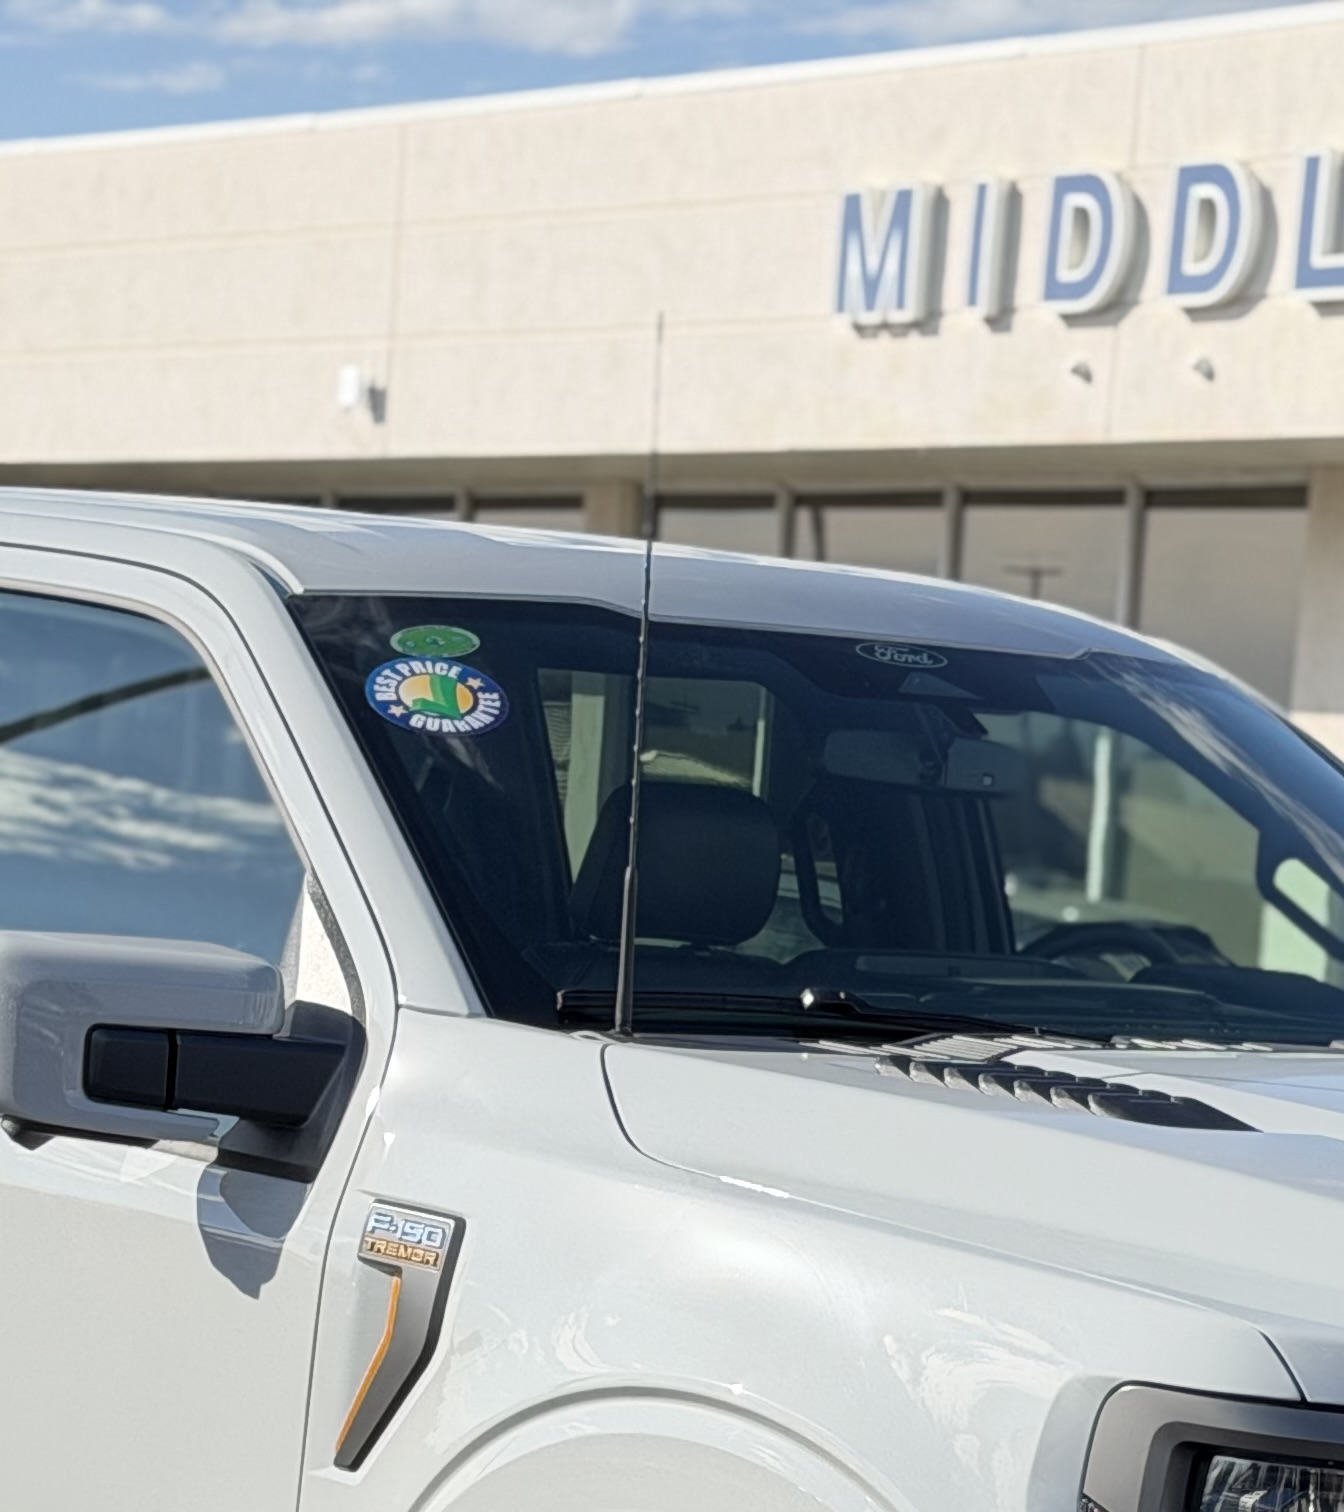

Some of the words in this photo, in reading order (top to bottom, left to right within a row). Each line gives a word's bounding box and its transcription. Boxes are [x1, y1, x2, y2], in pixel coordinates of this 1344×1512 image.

[873, 645, 935, 666] Ford
[373, 668, 404, 701] BEST
[394, 660, 463, 680] PRICE
[408, 691, 502, 733] GUARANTEE
[365, 1212, 446, 1249] F-150
[363, 1236, 440, 1268] TREMOR
